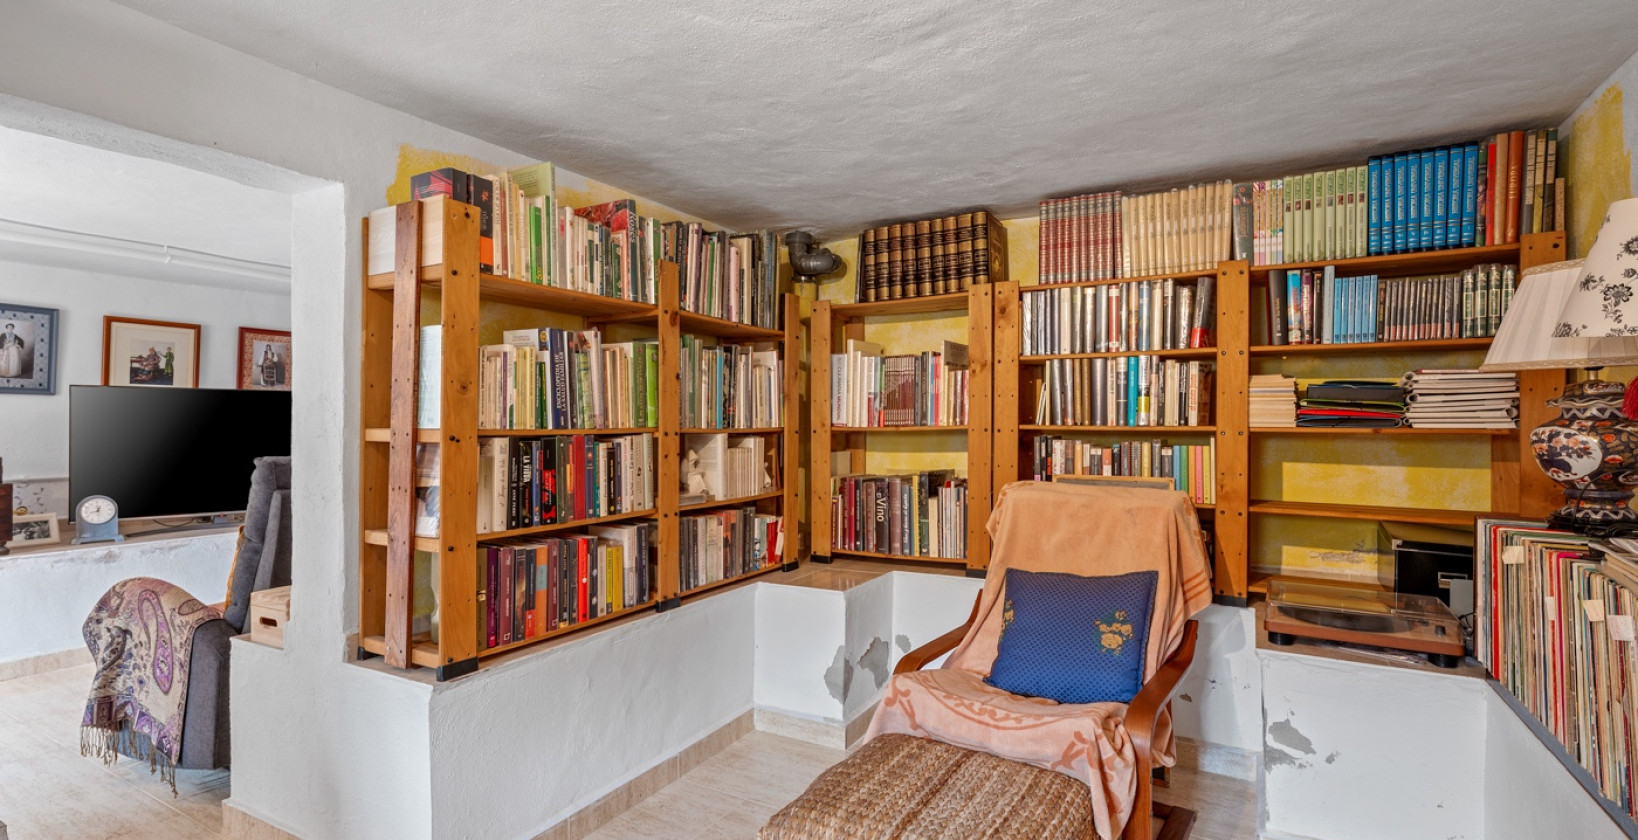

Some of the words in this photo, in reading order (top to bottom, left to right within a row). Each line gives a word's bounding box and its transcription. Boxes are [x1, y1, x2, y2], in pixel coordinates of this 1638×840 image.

[1509, 164, 1518, 199] EUROPA
[523, 455, 531, 463] LA
[876, 496, 887, 522] Vino
